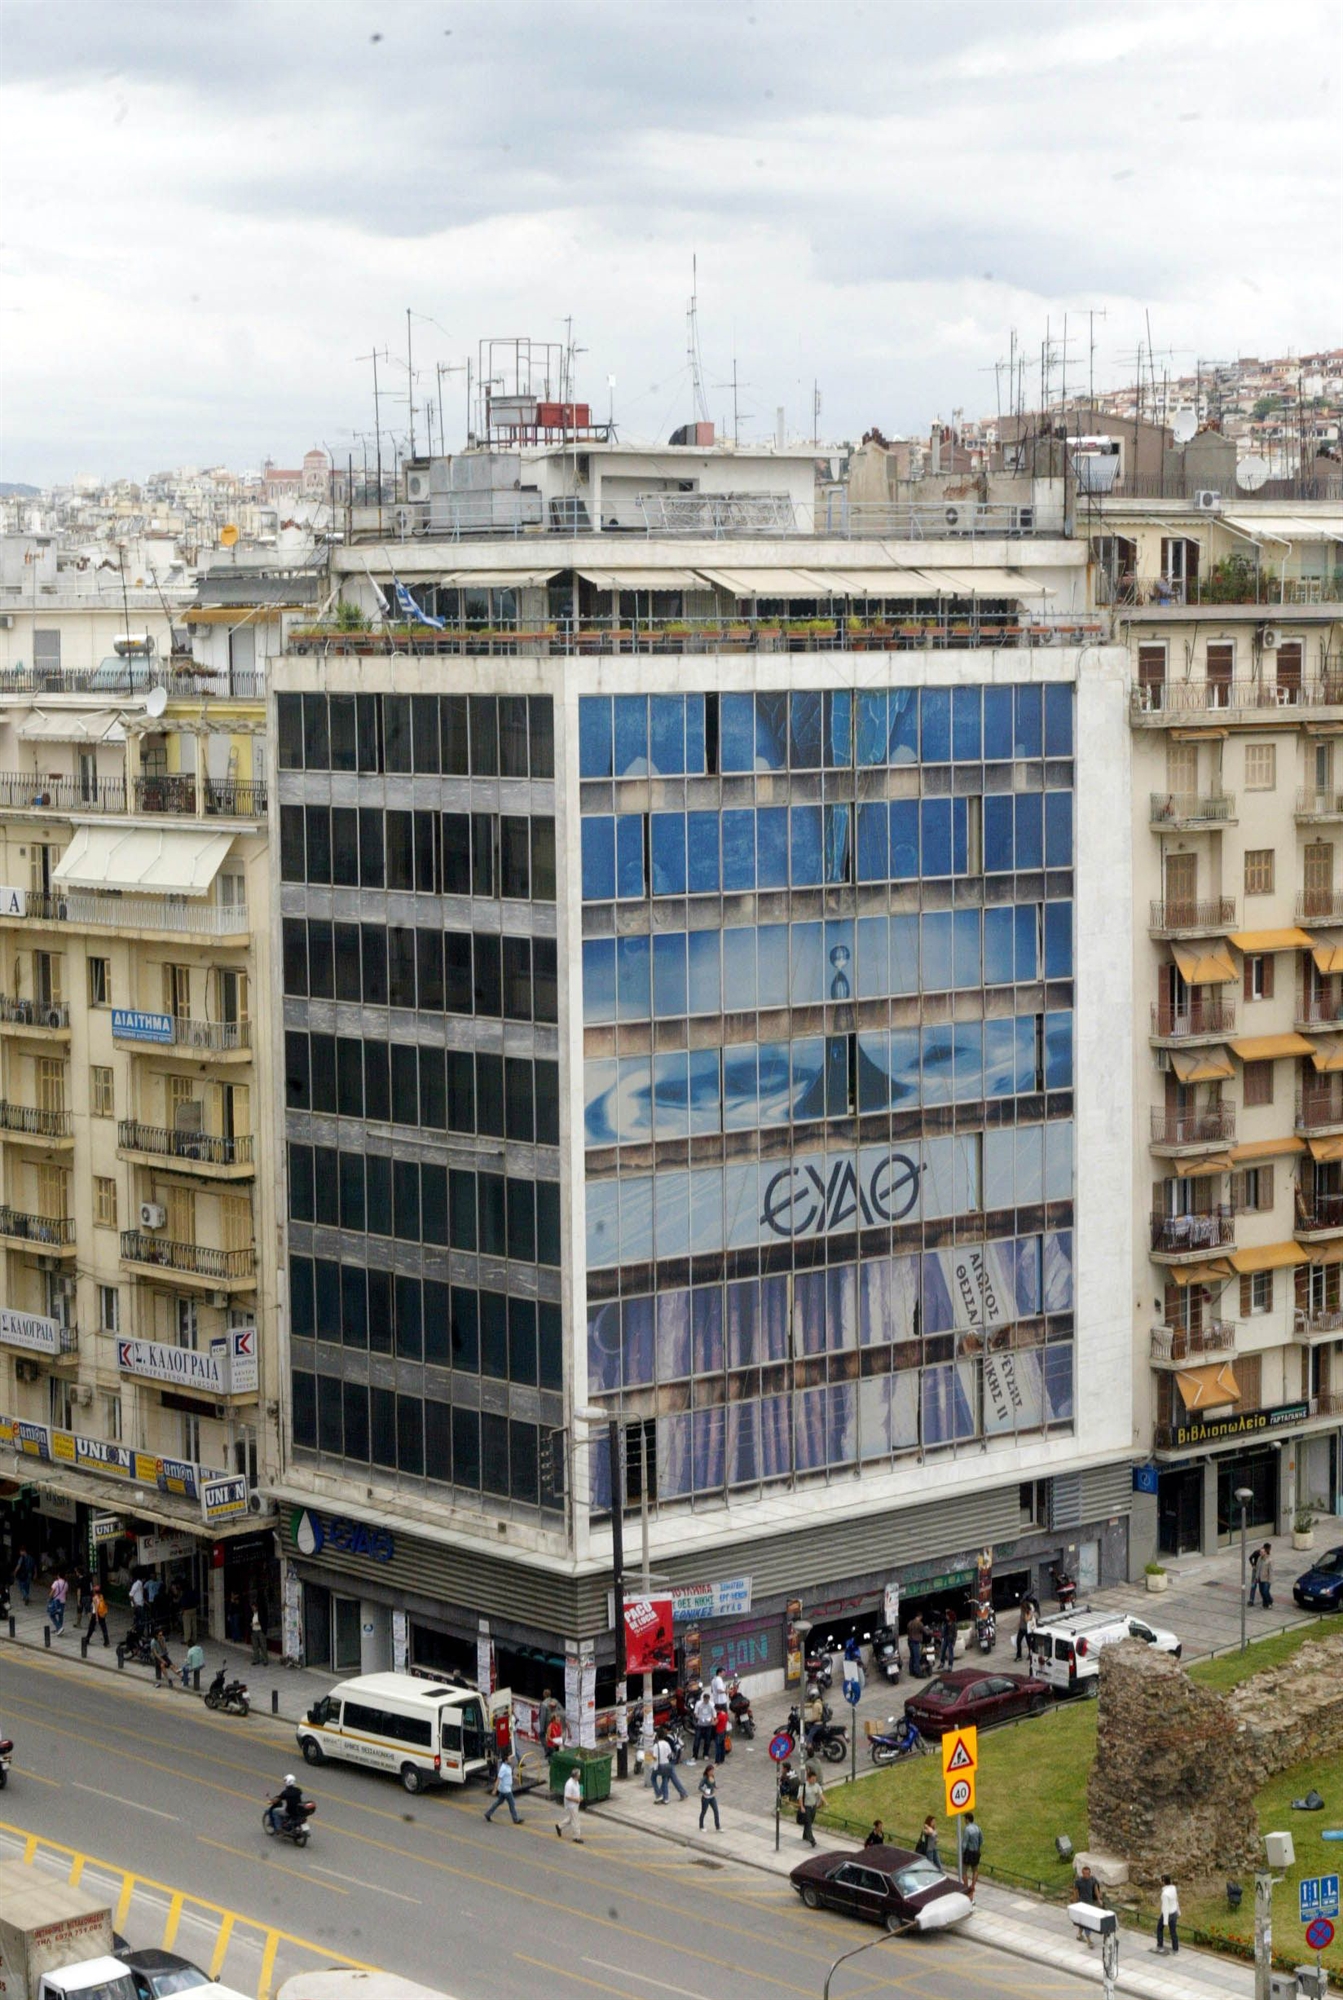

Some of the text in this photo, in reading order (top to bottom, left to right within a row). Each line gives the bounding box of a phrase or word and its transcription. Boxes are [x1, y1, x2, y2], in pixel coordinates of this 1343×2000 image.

[114, 1011, 170, 1032] ΔΙΑΙΤΗΜΑ
[969, 1252, 1000, 1321] ΑΓΩΓΟΣ
[10, 1316, 54, 1342] ΚΑΛΟΓΡΑΙΑ
[149, 1346, 219, 1381] ΚΑΛΟΓΡΑΙΑ
[76, 1438, 130, 1467] UNION
[206, 1483, 244, 1506] UNION
[624, 1601, 653, 1623] PACO
[954, 1787, 967, 1799] 40
